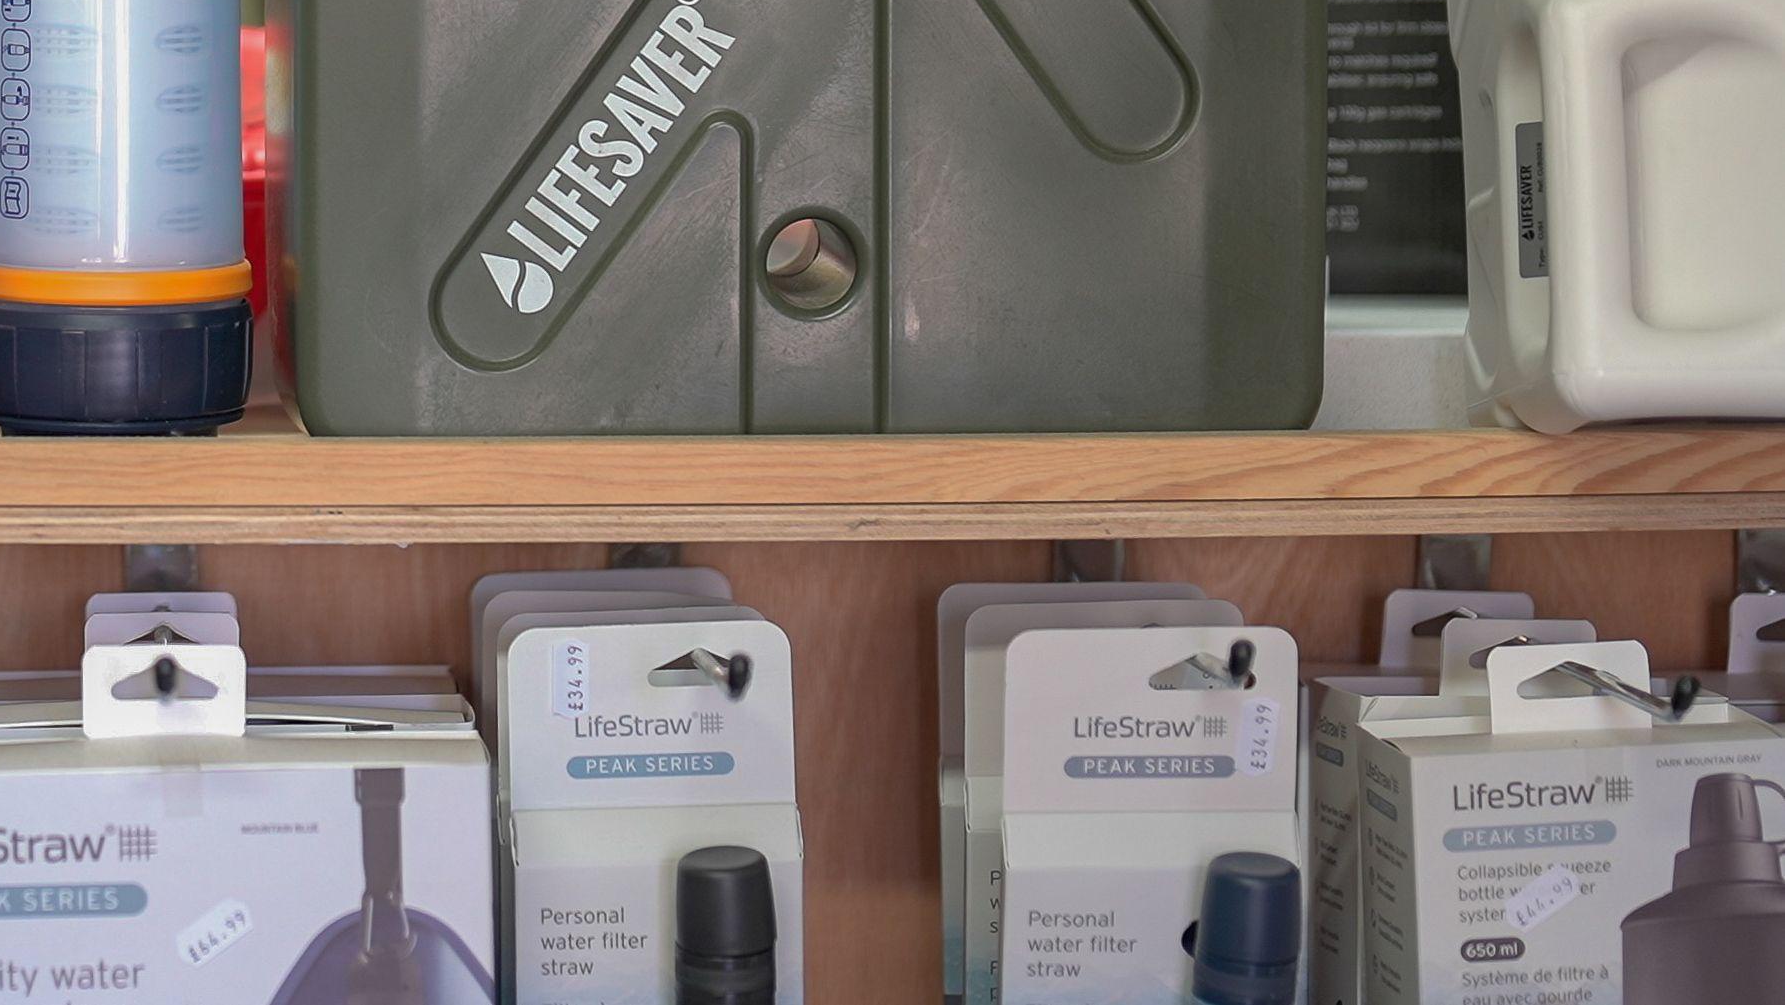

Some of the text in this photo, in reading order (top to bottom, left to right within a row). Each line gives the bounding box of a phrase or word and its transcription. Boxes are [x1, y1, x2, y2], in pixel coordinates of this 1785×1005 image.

[1520, 164, 1534, 230] LIFESAVER
[567, 644, 584, 712] £34.99
[1250, 704, 1272, 772] £34.99
[586, 756, 714, 774] PEAK SERIES
[1083, 759, 1215, 774] PEAK SERIES
[1656, 758, 1683, 768] DARK
[1685, 755, 1734, 767] MOUNTAIN
[1463, 824, 1596, 847] PEAK SERIES
[1457, 862, 1543, 881] Collapsible
[24, 890, 120, 912] SERIES
[1459, 885, 1504, 902] bottle
[541, 906, 625, 925] Personal
[1028, 909, 1115, 928] Personal
[541, 932, 648, 950] water filter
[1027, 935, 1138, 953] water filter
[1466, 943, 1518, 958] 650 ml
[52, 959, 145, 990] water
[541, 959, 594, 976] straw
[1027, 961, 1081, 978] straw
[1463, 964, 1609, 989] Système de filtre à
[1497, 992, 1533, 1005] avec
